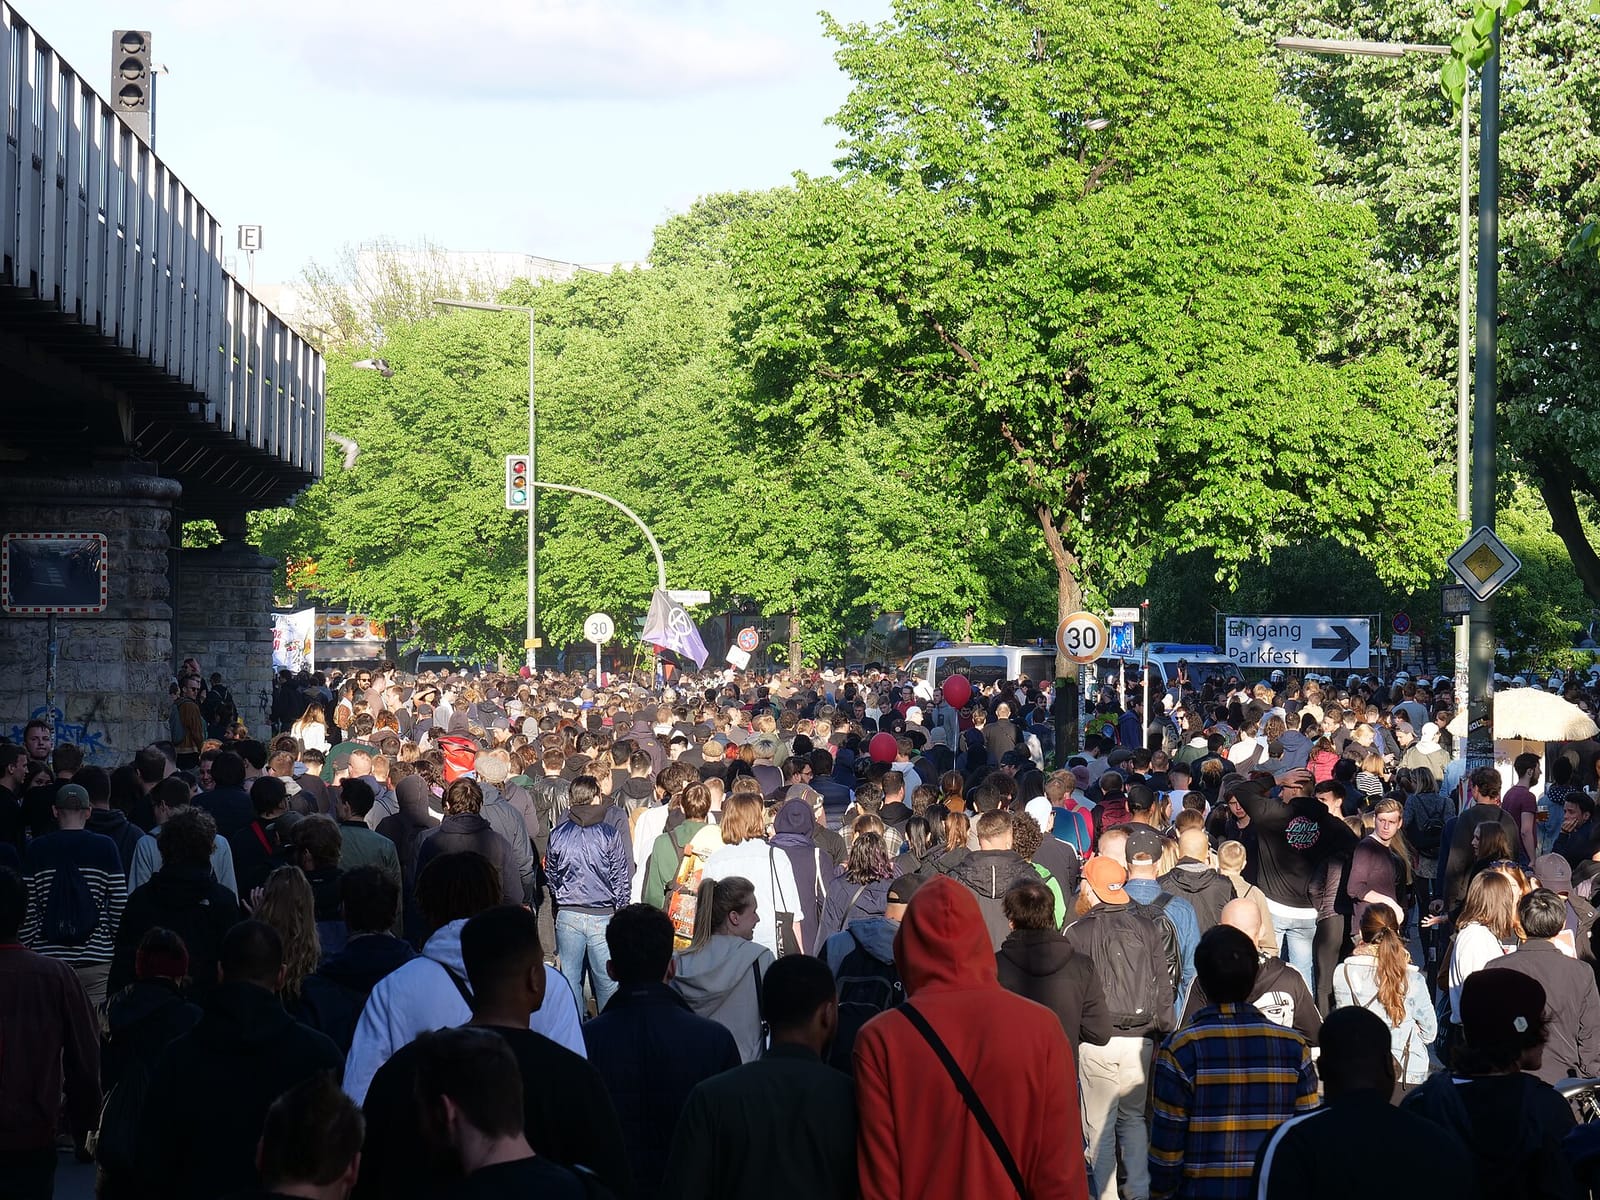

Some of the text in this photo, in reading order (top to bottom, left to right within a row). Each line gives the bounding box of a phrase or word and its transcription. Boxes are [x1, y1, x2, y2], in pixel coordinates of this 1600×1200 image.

[245, 228, 256, 247] E
[590, 622, 608, 636] 30
[1067, 626, 1097, 649] 30
[1229, 620, 1301, 641] Eingang
[1229, 646, 1300, 664] Parkfest
